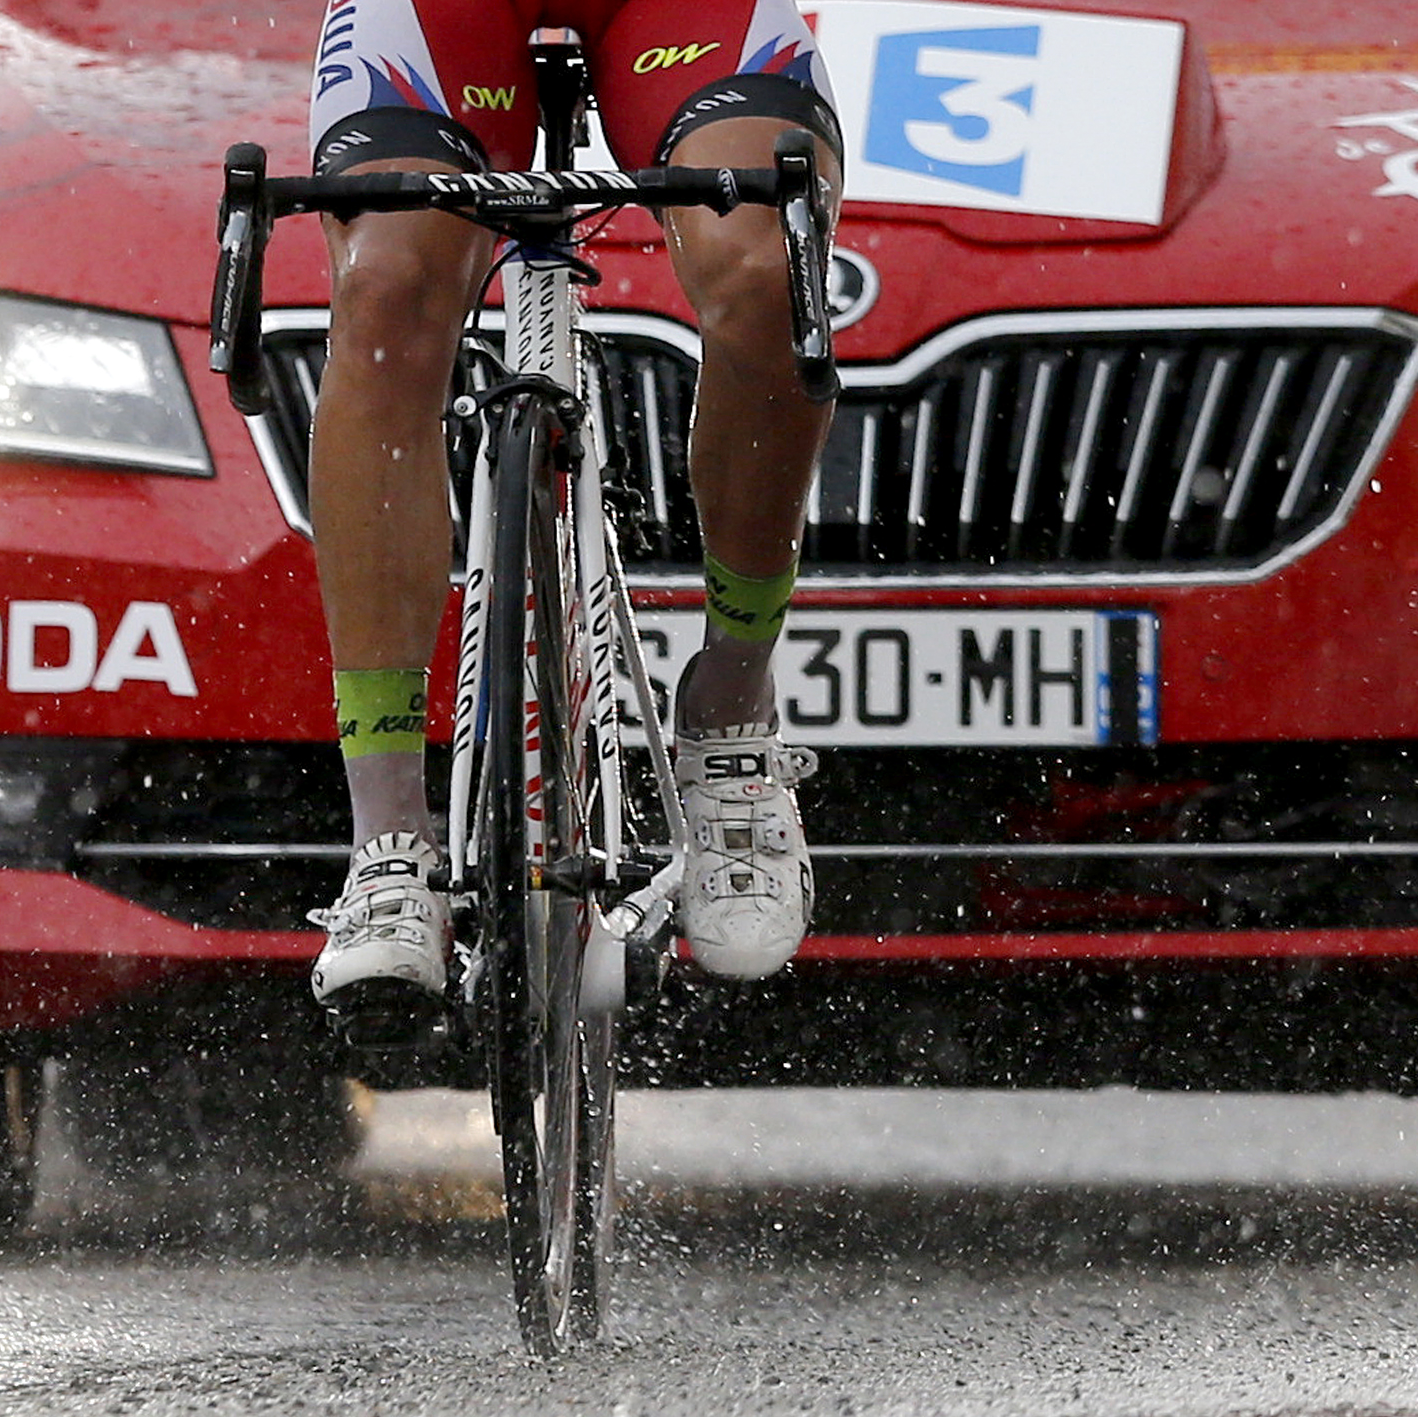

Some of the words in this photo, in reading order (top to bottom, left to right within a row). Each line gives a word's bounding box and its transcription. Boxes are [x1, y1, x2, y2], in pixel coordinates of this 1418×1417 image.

[633, 42, 722, 74] OW
[463, 85, 516, 111] OW
[903, 45, 1036, 167] 3
[428, 170, 638, 192] CANYON
